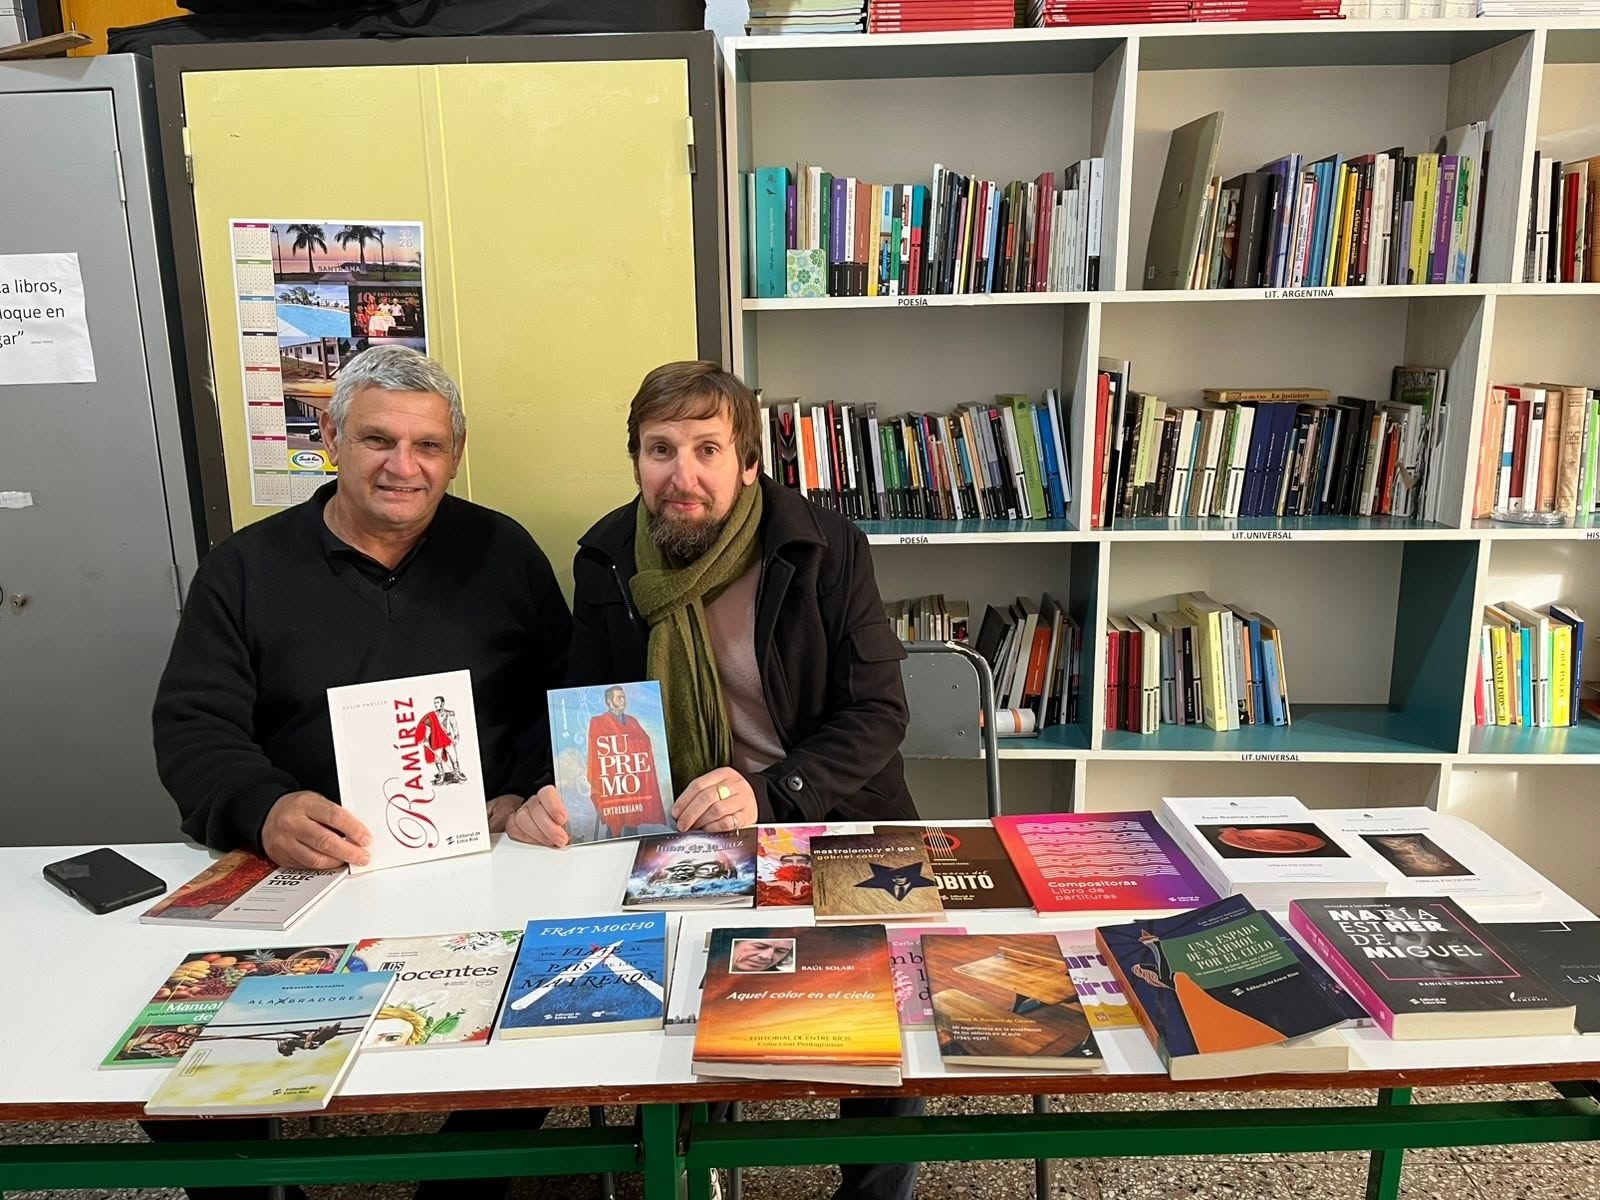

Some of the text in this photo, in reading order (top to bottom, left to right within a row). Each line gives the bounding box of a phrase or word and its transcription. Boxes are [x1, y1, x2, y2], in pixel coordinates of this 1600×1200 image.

[14, 278, 63, 295] libros,
[1264, 289, 1335, 299] LIT. ARGENTINA
[898, 296, 929, 307] POESÍA
[46, 306, 65, 319] en
[900, 534, 929, 545] POESÍA
[1232, 530, 1293, 540] LIT.UNIVERSAL
[596, 733, 629, 757] SU
[1241, 753, 1300, 762] LIT.UNIVERSAL
[597, 751, 651, 777] PRE
[382, 696, 440, 849] RAMÍREZ
[599, 773, 641, 798] MO
[813, 847, 875, 855] mastroianni
[816, 853, 855, 861] gabriel
[267, 879, 301, 887] TIVO
[1047, 879, 1138, 889] Compositoras
[1050, 886, 1084, 894] Libro
[1054, 892, 1119, 901] partituras
[1327, 906, 1439, 921] MARÍA
[540, 921, 656, 937] FRAY MOCHO
[1338, 921, 1448, 933] ESTHER
[1187, 923, 1260, 952] UNA ESPADA
[1346, 933, 1392, 947] DE
[1186, 935, 1258, 962] DE MÁRMOL
[1361, 944, 1483, 959] MIGUEL
[1196, 956, 1223, 971] POR
[1222, 951, 1241, 963] EL
[1239, 939, 1275, 958] CIELO
[379, 960, 406, 972] LOS
[801, 963, 824, 971] RAÚL
[519, 969, 657, 991] MATREROS
[726, 990, 767, 1001] Aquel
[769, 990, 806, 1000] color
[828, 990, 840, 999] el
[842, 990, 876, 1000] cielo
[166, 1001, 224, 1012] Manual
[192, 1013, 214, 1022] de
